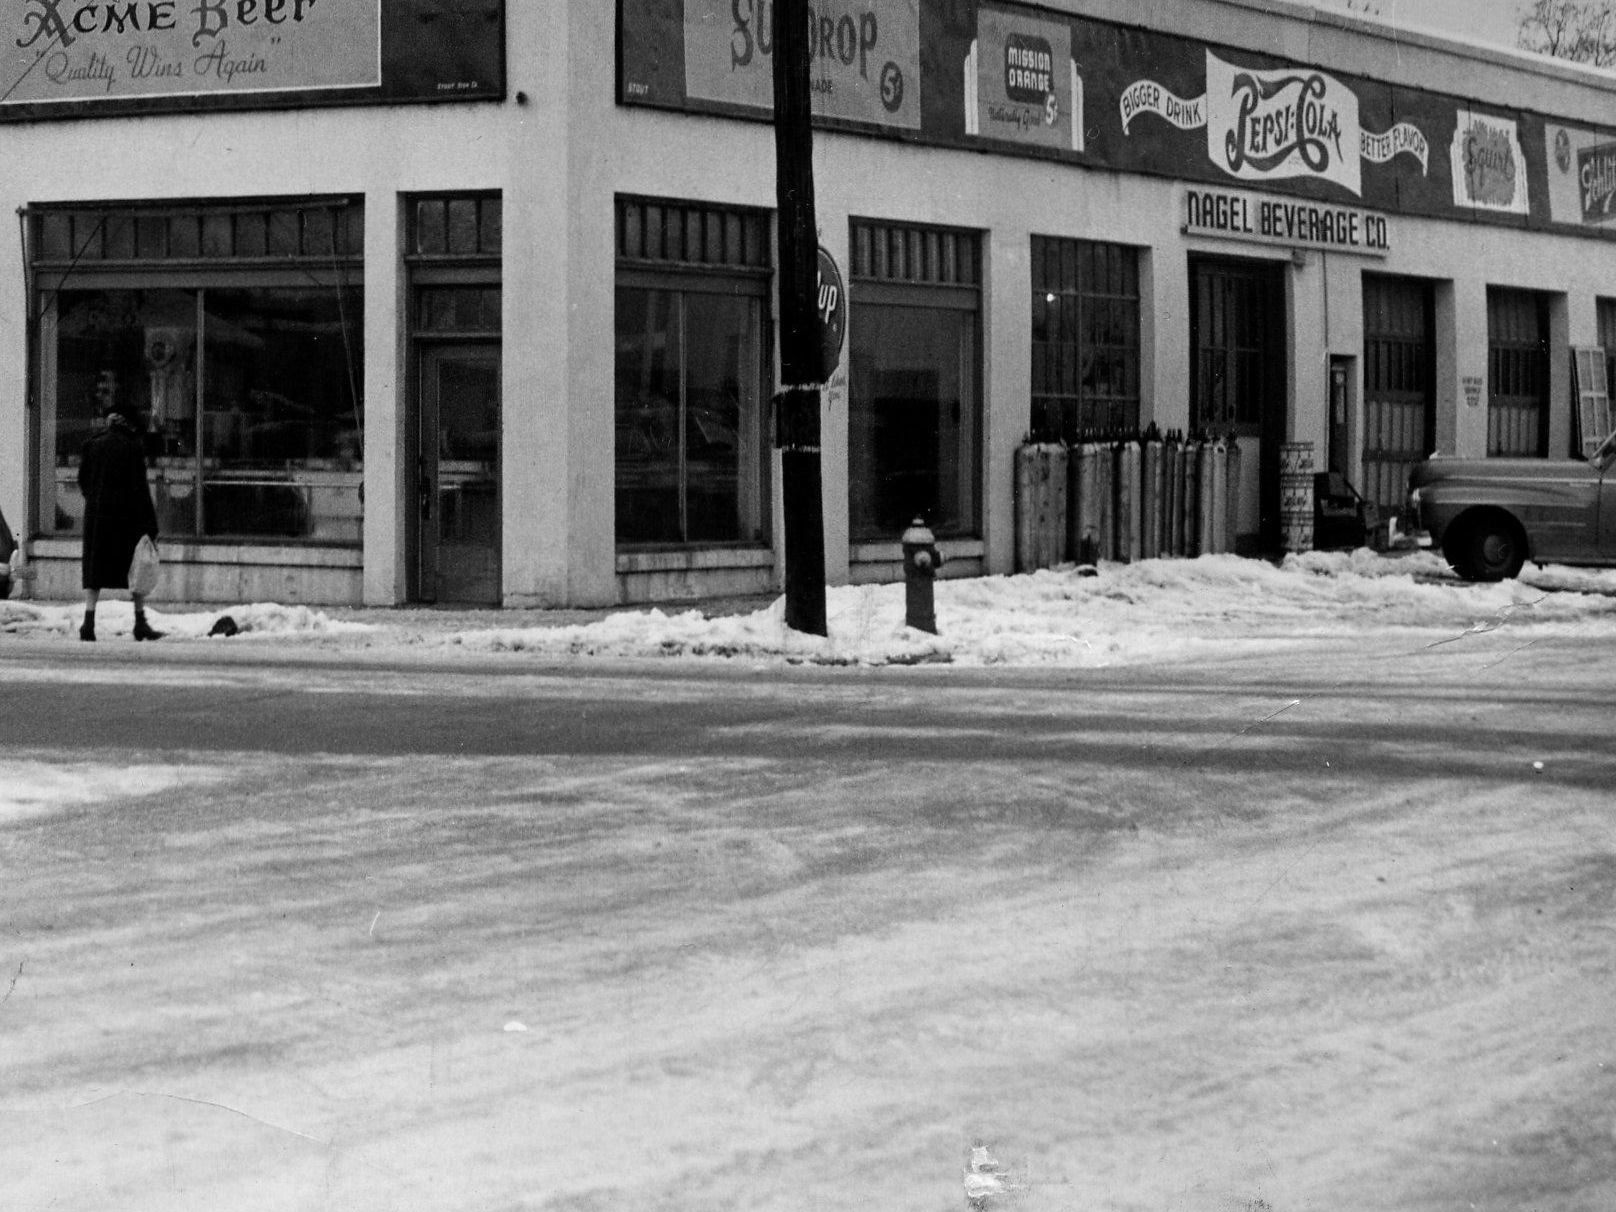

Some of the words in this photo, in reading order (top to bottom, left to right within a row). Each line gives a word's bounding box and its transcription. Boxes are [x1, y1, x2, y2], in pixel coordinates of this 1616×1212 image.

[126, 45, 182, 80] Wins
[1008, 47, 1050, 71] MISSION
[1008, 68, 1050, 92] ORANGE
[1045, 94, 1058, 126] 5¢
[1122, 84, 1160, 119] BIGGER
[1166, 95, 1202, 126] DRINK
[1360, 132, 1392, 159] BETTER
[1393, 126, 1425, 160] FLAVOR
[1464, 136, 1516, 189] Squirt
[1188, 191, 1253, 234] NAGEL
[1260, 201, 1359, 246] BEVERAGE
[1365, 214, 1390, 251] CO.
